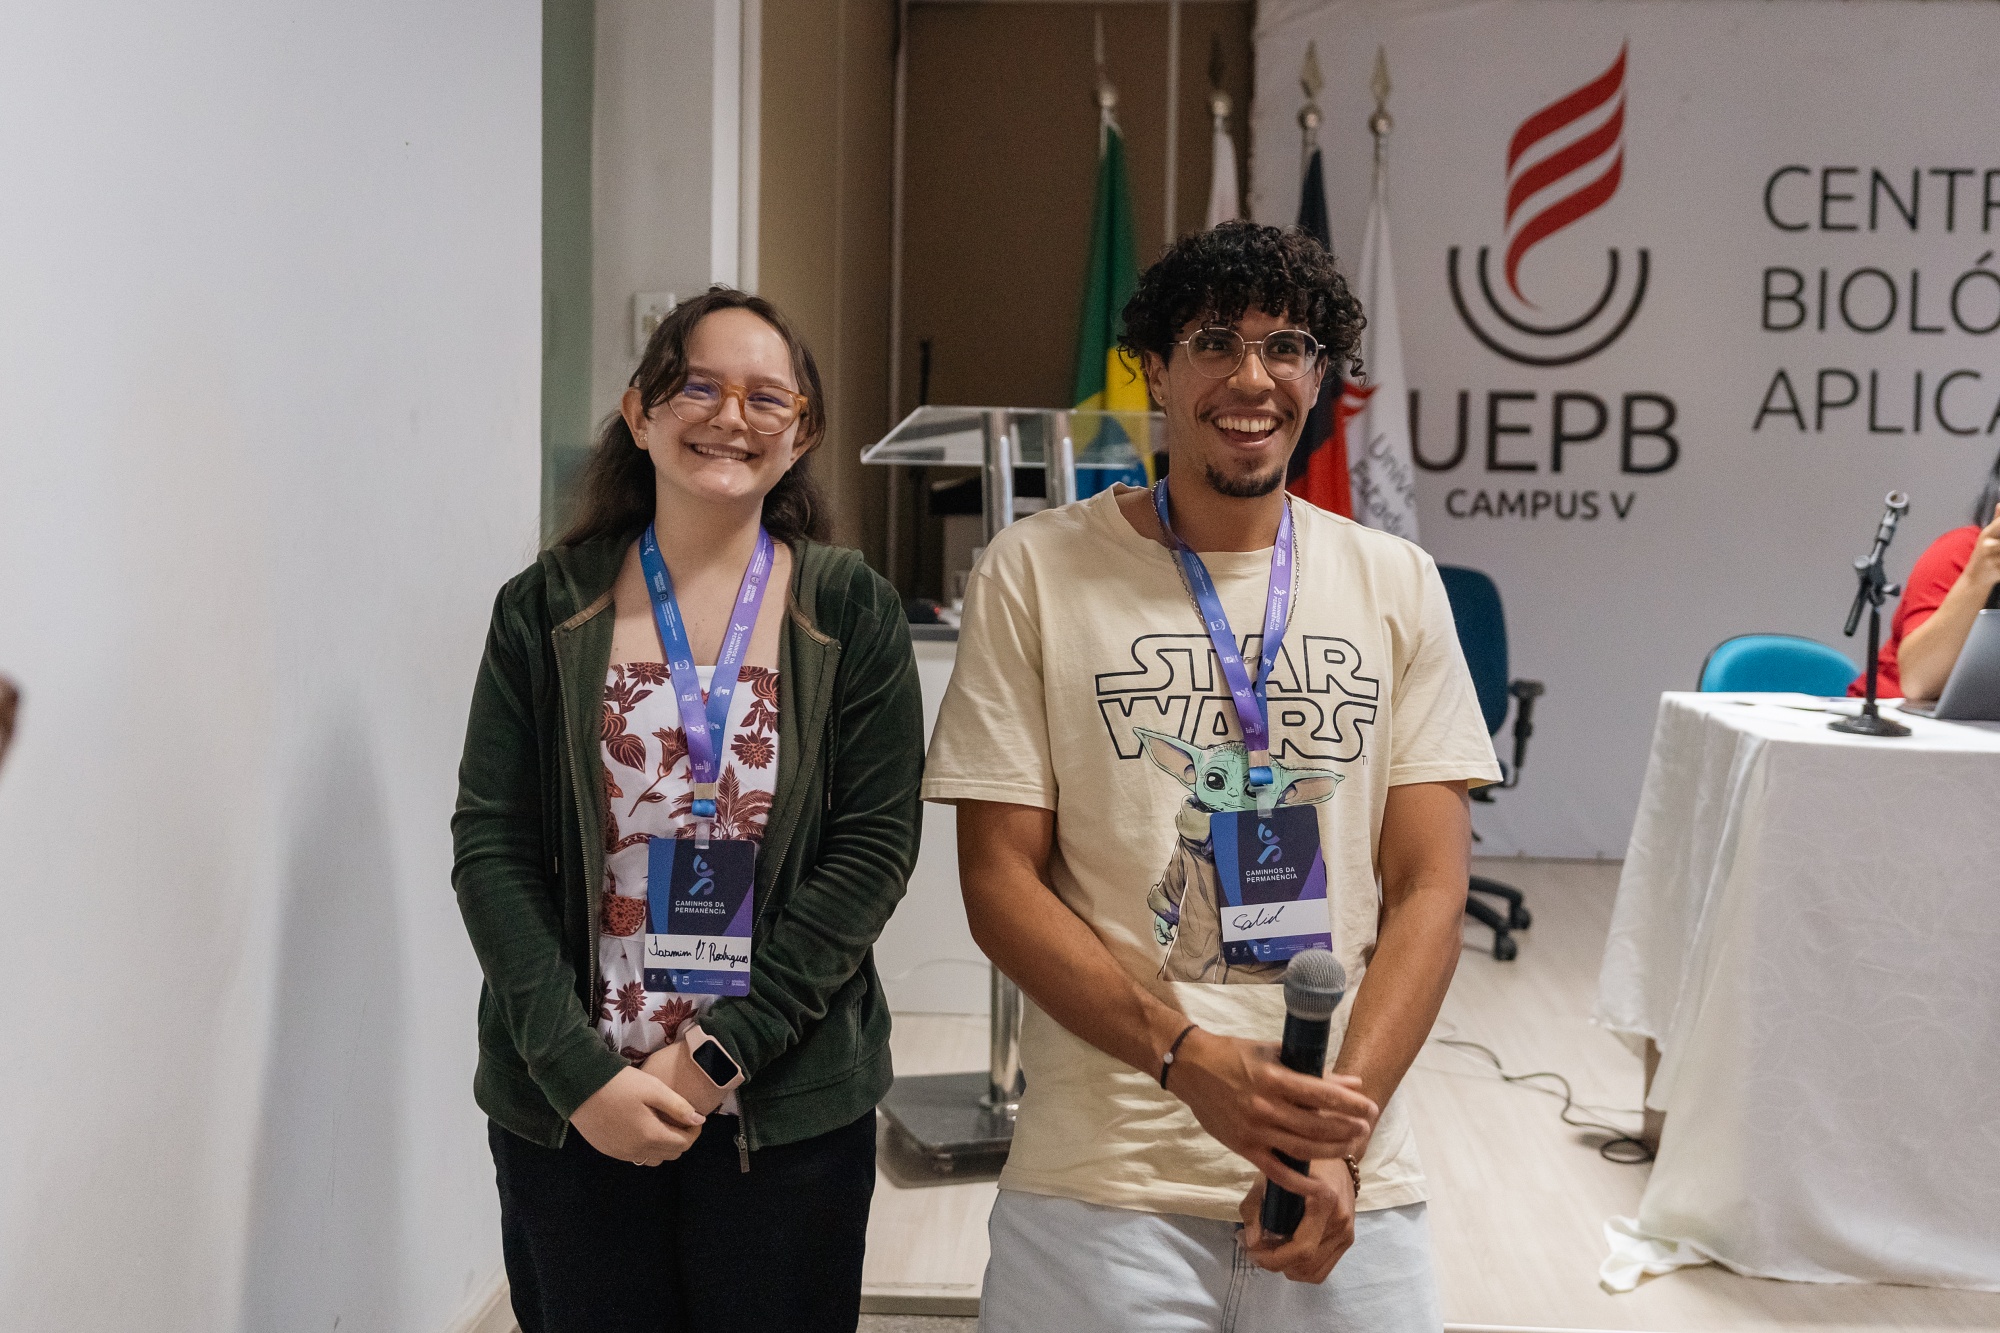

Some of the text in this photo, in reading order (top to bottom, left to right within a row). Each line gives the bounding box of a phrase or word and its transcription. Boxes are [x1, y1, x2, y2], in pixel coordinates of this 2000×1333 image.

[1762, 250, 2000, 335] BIOLÓ
[1407, 389, 1681, 474] UEPB
[1753, 367, 2000, 436] APLIC
[1445, 488, 1636, 520] CAMPUS V
[1095, 634, 1380, 701] STAR
[1098, 695, 1378, 763] WARS
[1245, 867, 1284, 877] CAMINHOS
[1246, 873, 1298, 883] PERMANÊNCIA
[674, 907, 726, 915] PERMANÊNCIA
